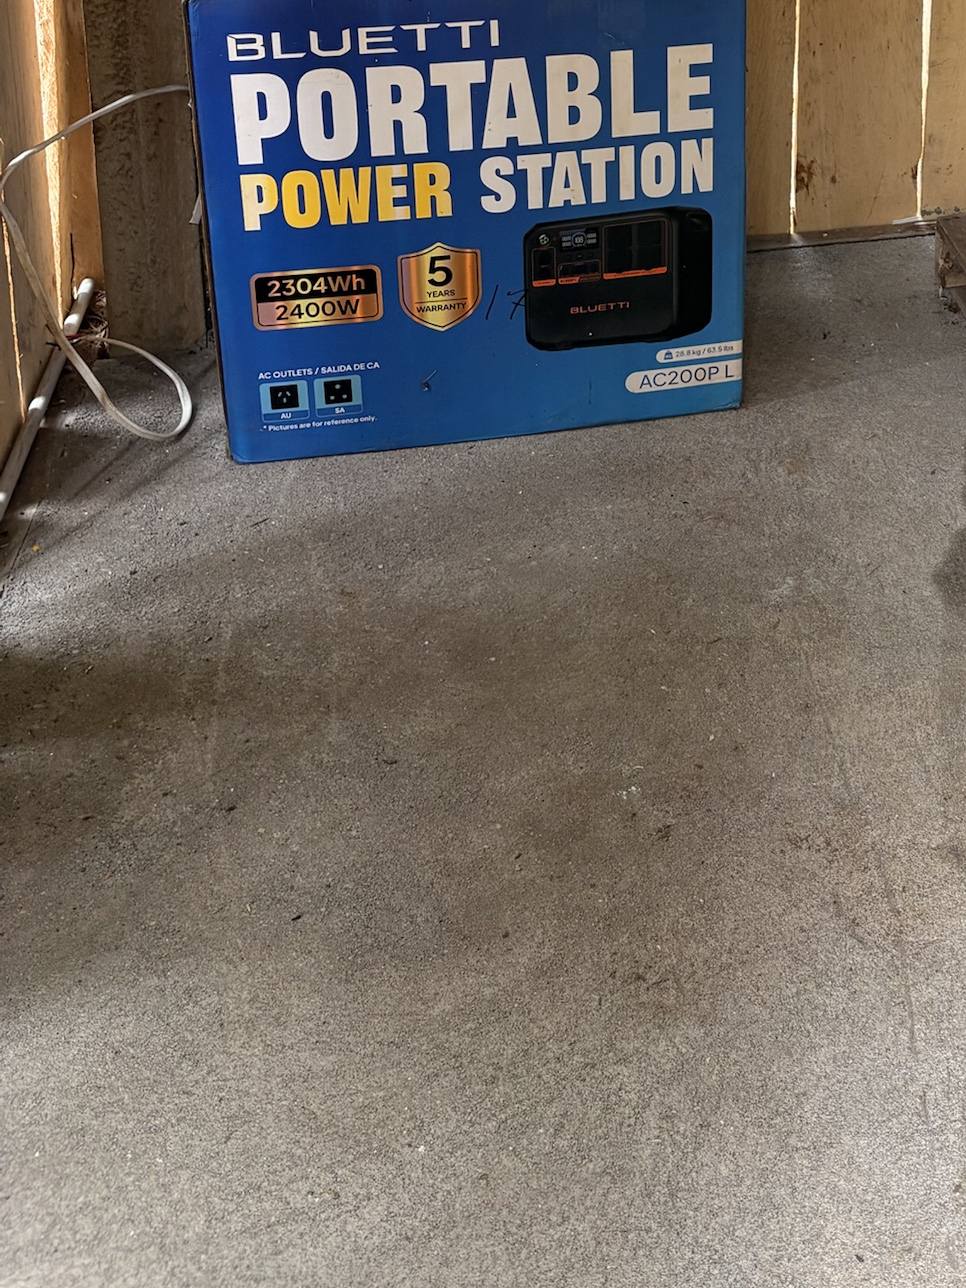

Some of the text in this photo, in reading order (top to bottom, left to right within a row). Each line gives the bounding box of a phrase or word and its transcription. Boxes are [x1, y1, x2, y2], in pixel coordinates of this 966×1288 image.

[227, 18, 501, 62] BLUETTI
[230, 43, 715, 166] PORTABLE
[239, 137, 715, 231] POWER STATION
[427, 254, 453, 287] 5
[267, 274, 366, 297] 2304Wh
[426, 289, 456, 298] YEARS
[275, 298, 360, 321] 2400W
[416, 302, 467, 313] WARRANTY
[570, 301, 630, 314] BLUETTI
[258, 372, 271, 380] AC
[273, 368, 313, 378] OUTLETS
[321, 364, 352, 373] SALIDA
[353, 362, 365, 370] DE
[639, 364, 734, 389] AC200P L
[324, 418, 359, 426] reference
